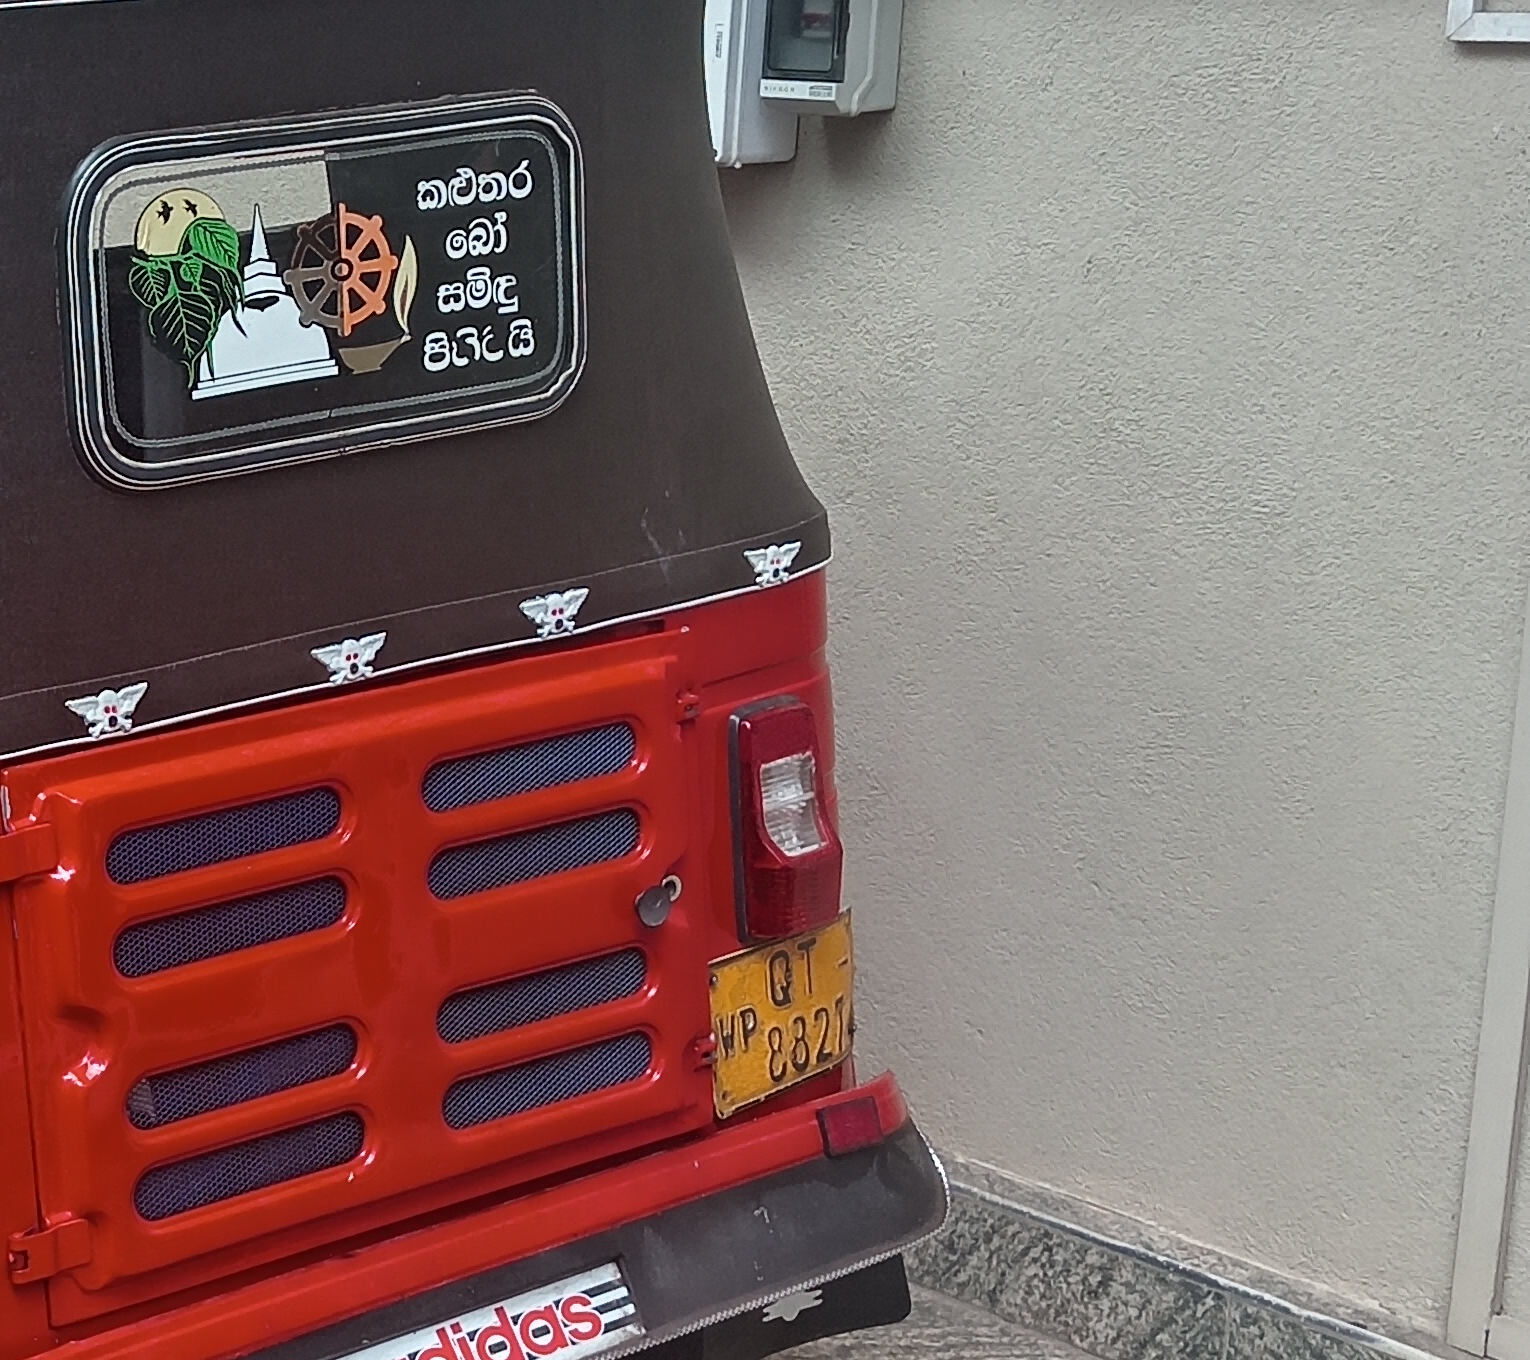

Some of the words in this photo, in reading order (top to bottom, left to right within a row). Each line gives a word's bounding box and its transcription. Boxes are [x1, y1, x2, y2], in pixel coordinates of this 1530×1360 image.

[416, 159, 534, 211] කළුතර
[445, 211, 509, 260] බෝ
[716, 1006, 758, 1060] WP
